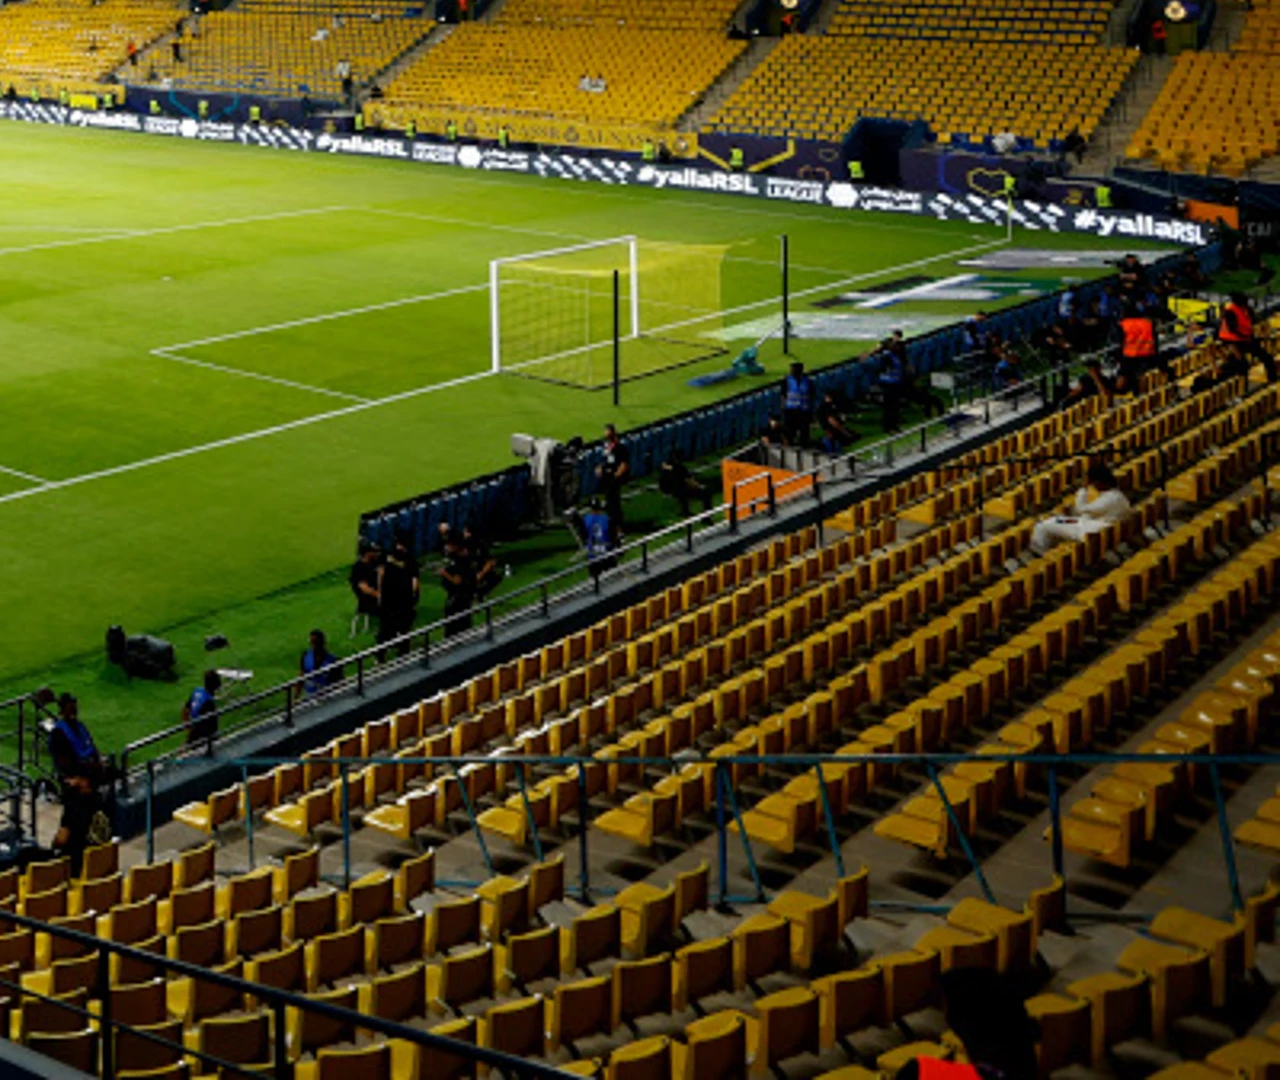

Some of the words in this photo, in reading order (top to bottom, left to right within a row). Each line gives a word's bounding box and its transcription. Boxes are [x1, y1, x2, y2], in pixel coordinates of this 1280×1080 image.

[316, 133, 409, 158] #yallaRSL
[638, 164, 759, 195] #yallaRSL
[1074, 208, 1207, 246] #yallaRSL
